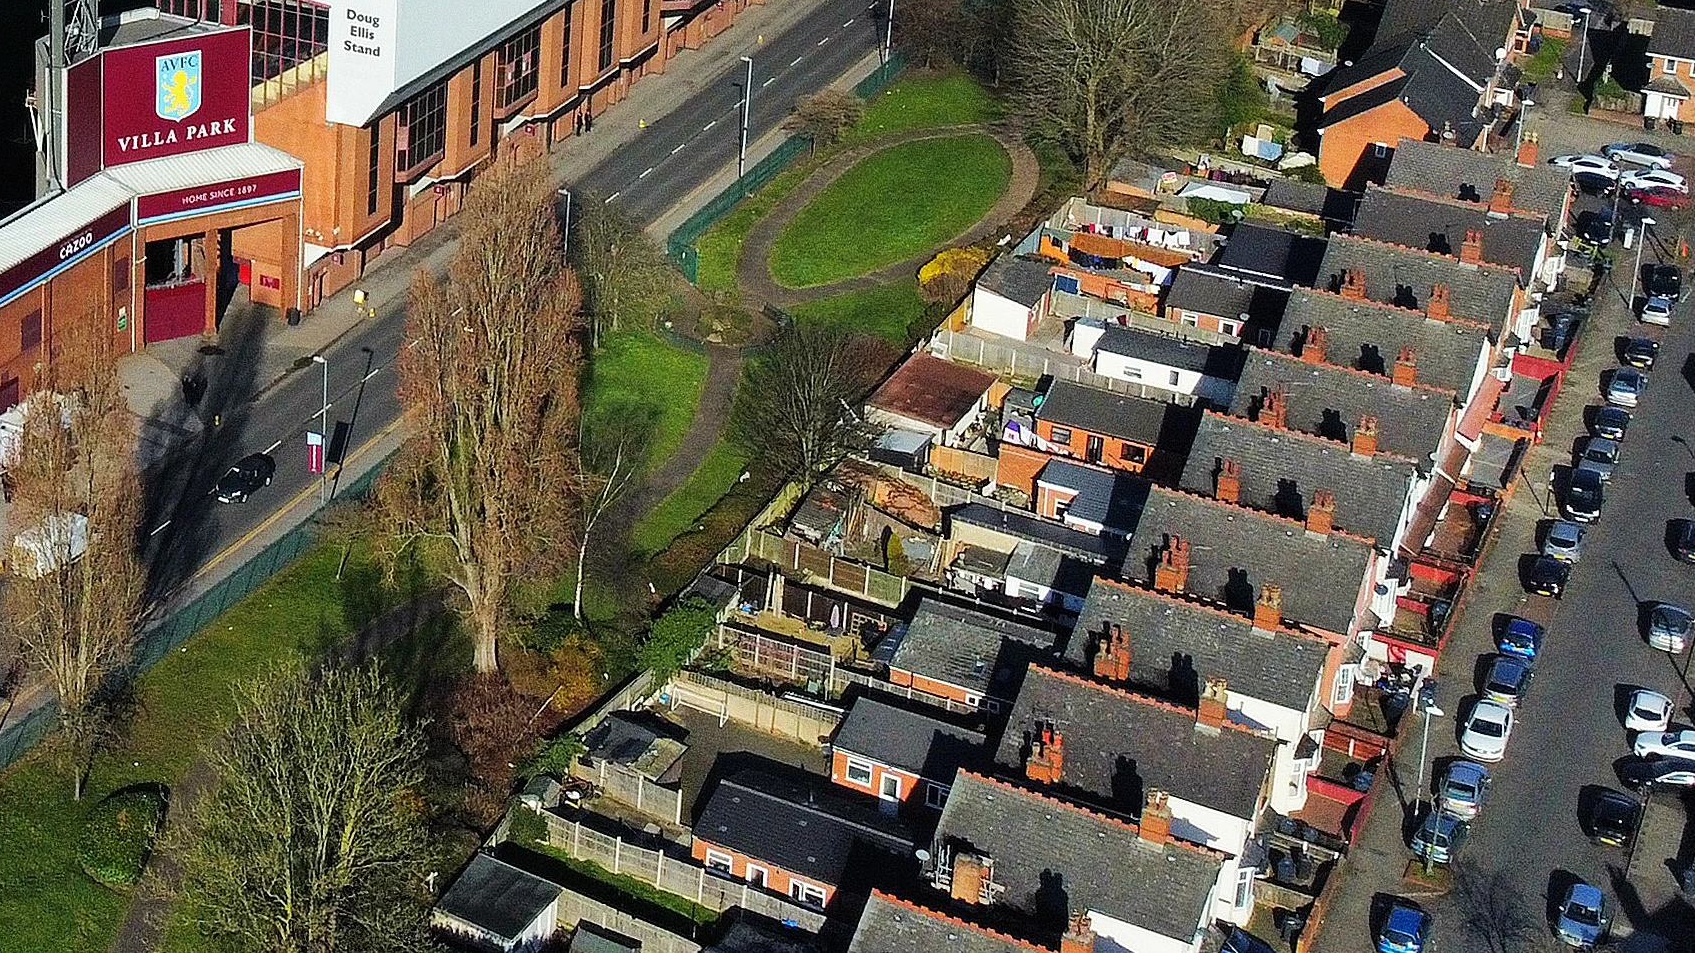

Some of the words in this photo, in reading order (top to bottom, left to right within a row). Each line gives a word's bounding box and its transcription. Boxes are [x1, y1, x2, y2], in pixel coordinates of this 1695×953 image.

[346, 8, 380, 28] Doug
[349, 25, 375, 41] Ellis
[343, 40, 381, 57] Stand
[160, 55, 198, 72] AVFC
[117, 127, 178, 152] VILLA
[186, 118, 237, 141] PARK
[182, 192, 207, 205] HOME
[209, 187, 234, 200] SINCE
[237, 184, 257, 196] 1897
[59, 232, 93, 259] CAZOO
